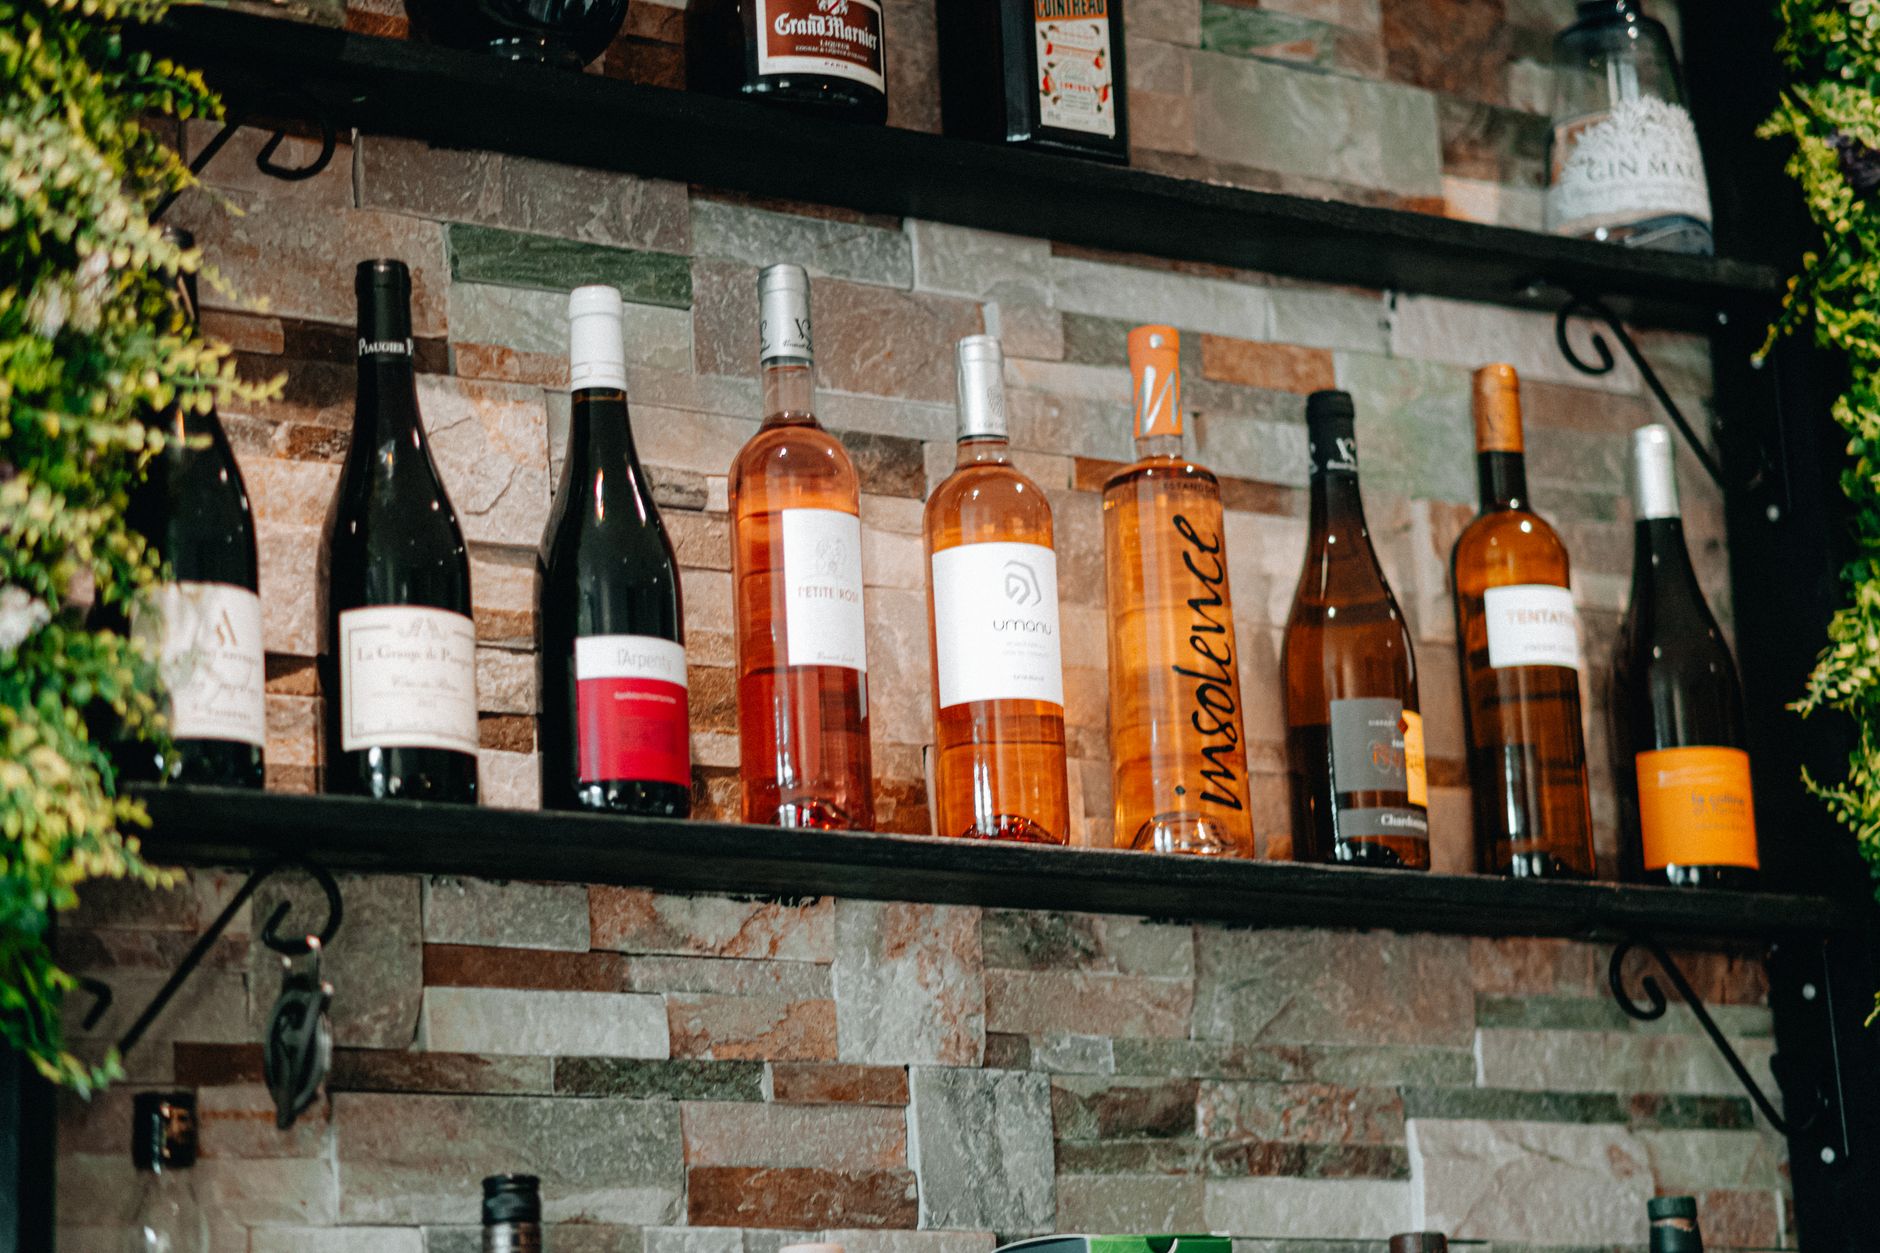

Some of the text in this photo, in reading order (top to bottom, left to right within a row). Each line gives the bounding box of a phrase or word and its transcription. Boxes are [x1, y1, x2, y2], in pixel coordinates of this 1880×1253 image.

[774, 12, 877, 50] Grand Marnier
[798, 586, 833, 600] PETITE
[1172, 513, 1243, 812] insolence
